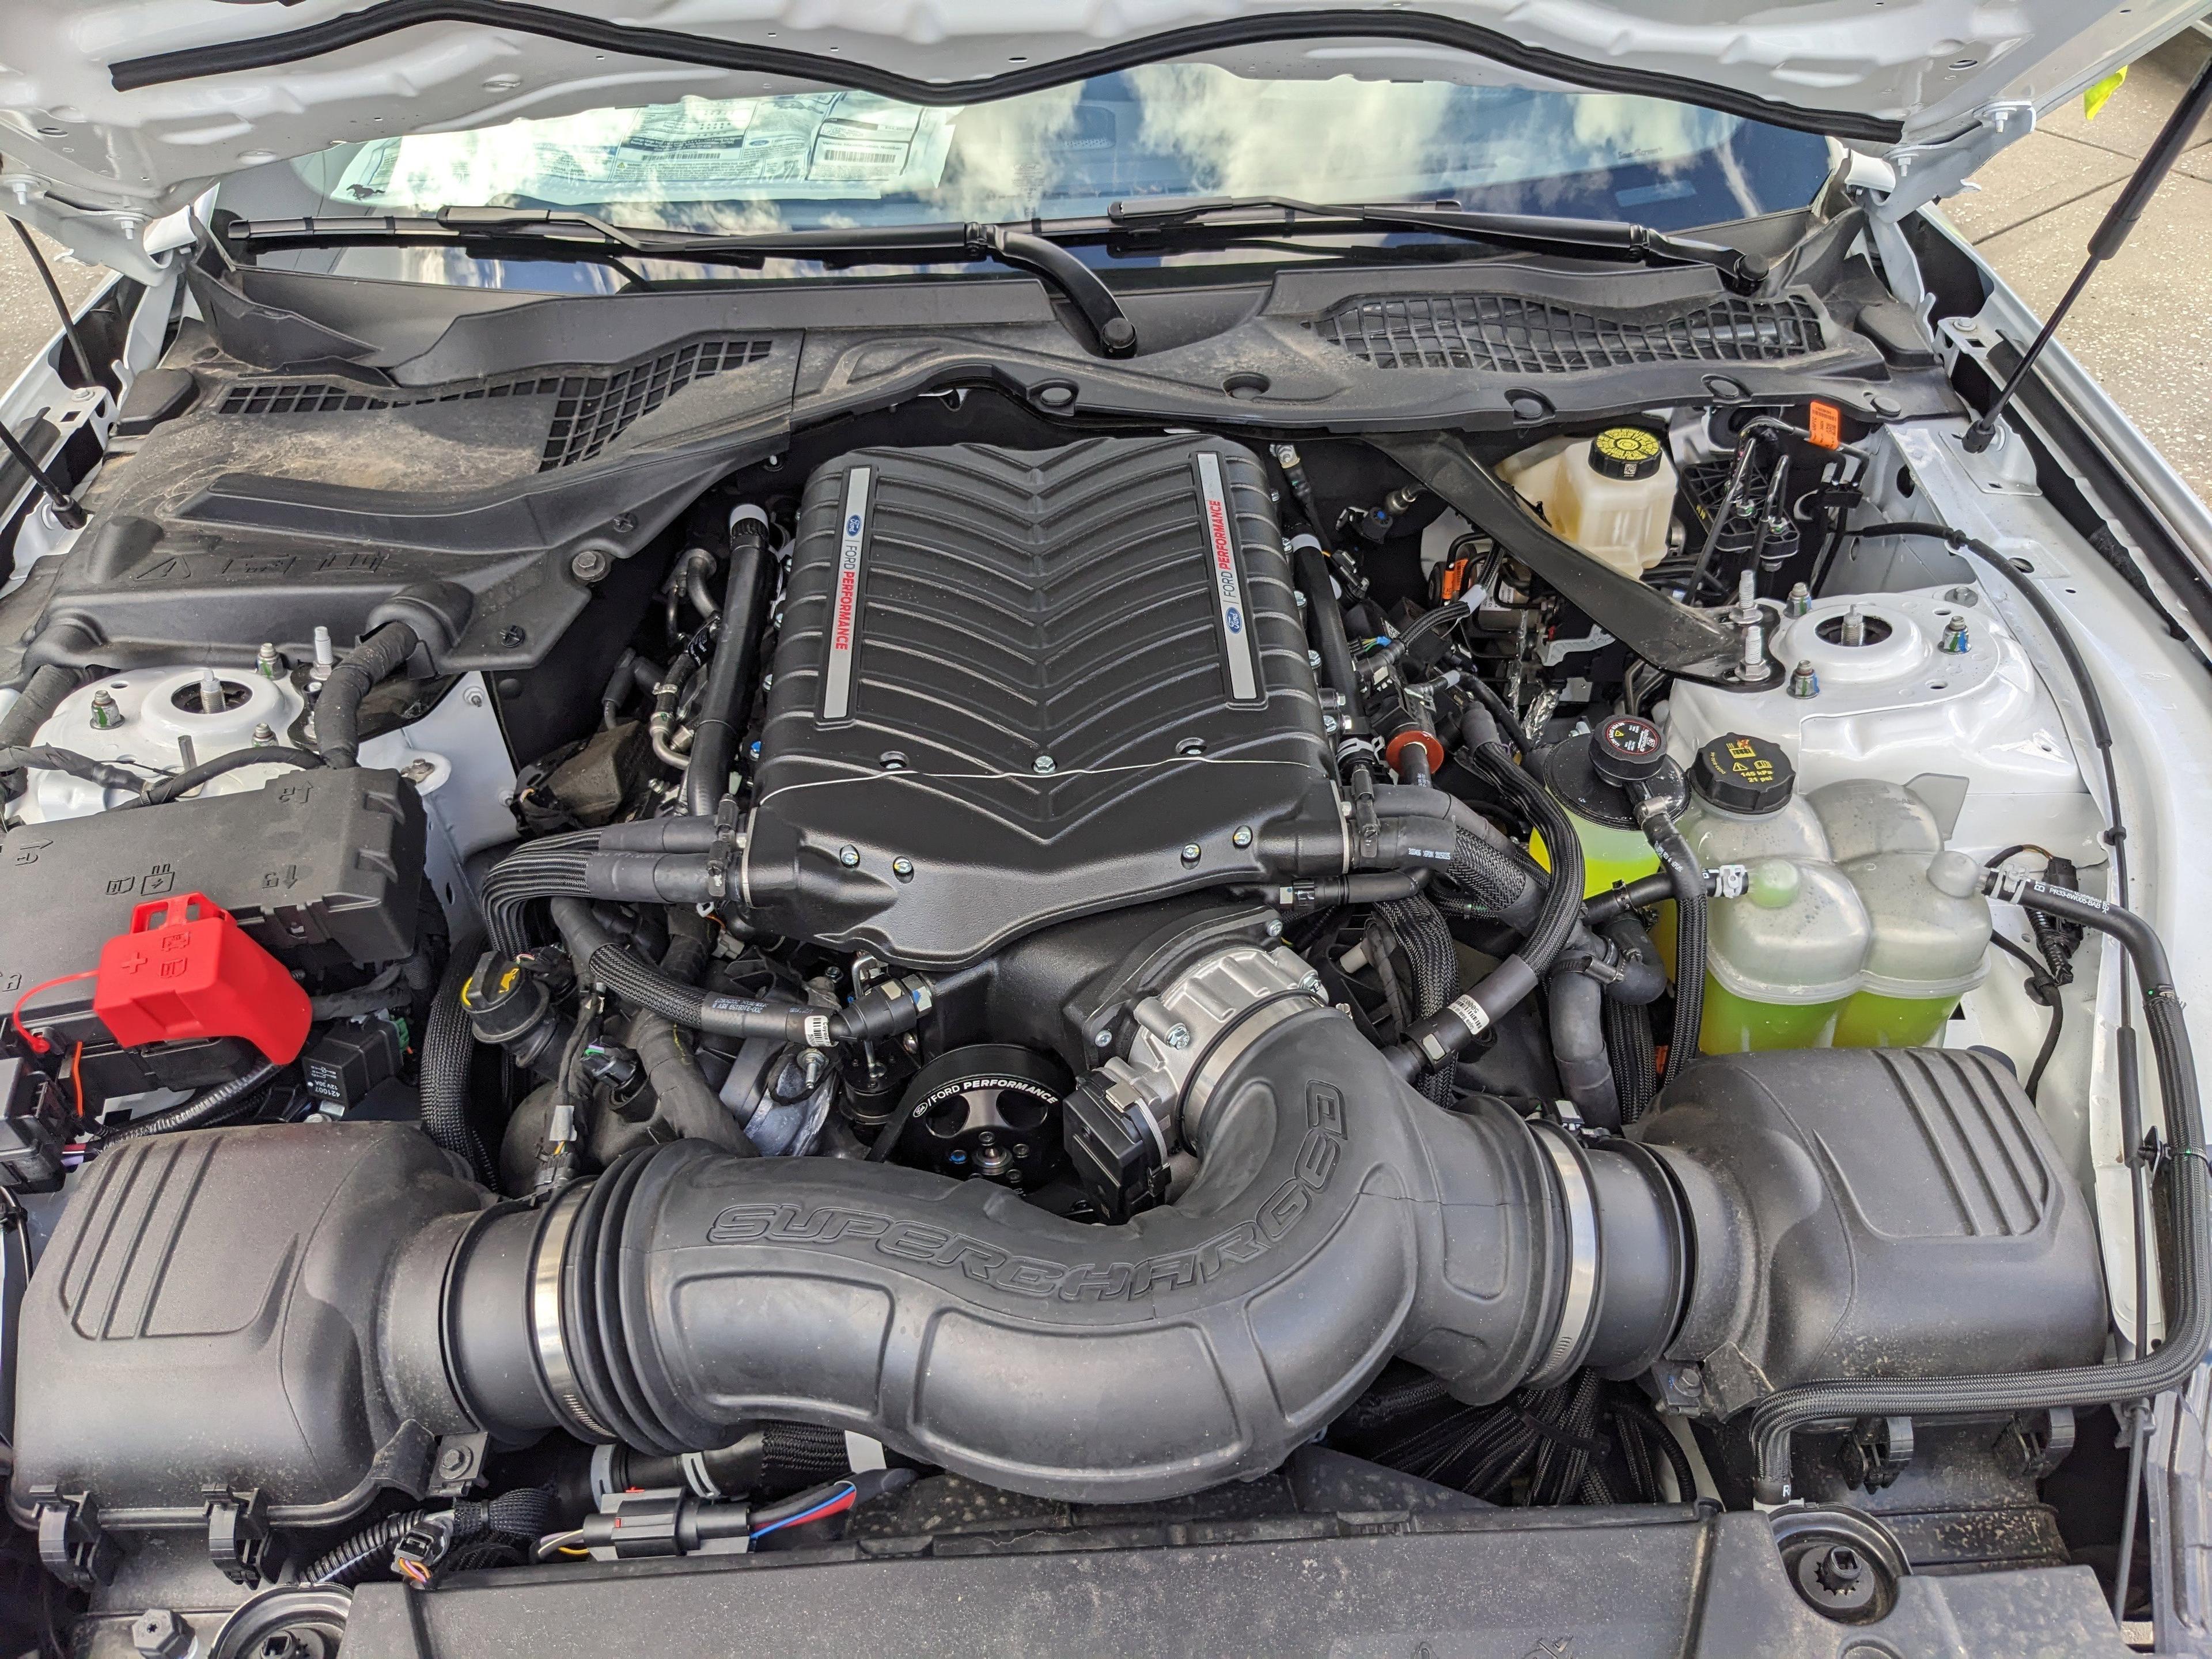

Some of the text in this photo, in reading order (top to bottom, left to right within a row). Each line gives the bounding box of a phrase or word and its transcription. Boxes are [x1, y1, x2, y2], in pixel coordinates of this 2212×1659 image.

[847, 515, 861, 535] Ford
[1207, 500, 1237, 599] FORD PERFORMANCE
[835, 545, 857, 650] FORD PERFORMANCE
[1227, 609, 1241, 631] Ford
[315, 1086, 340, 1097] 421007
[931, 1079, 1059, 1104] FORD PERFORMANCE
[707, 1080, 1351, 1301] SUPERCHARGED
